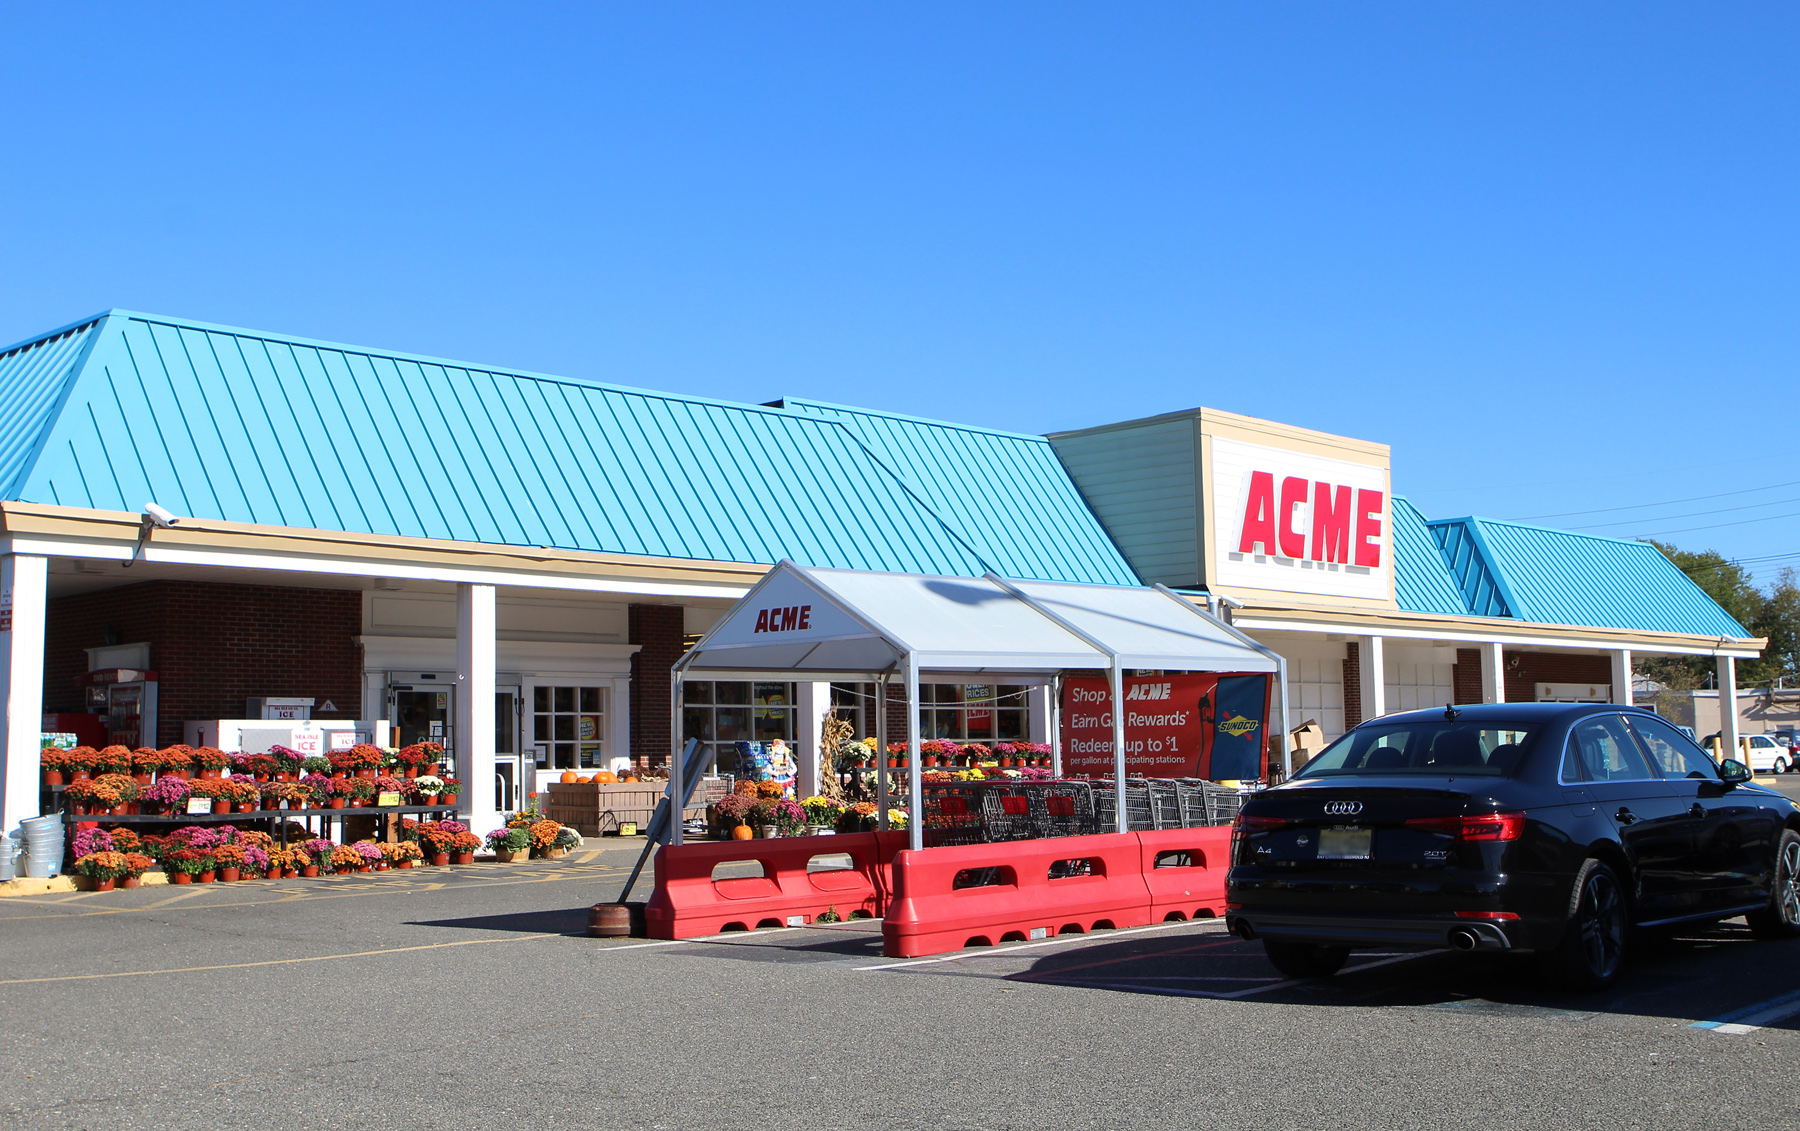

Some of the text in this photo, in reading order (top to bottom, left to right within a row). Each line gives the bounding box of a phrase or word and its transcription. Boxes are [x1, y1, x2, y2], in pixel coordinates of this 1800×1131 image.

[1239, 470, 1383, 568] ACME
[754, 605, 812, 634] ACME
[967, 688, 990, 698] RICES
[1072, 688, 1106, 705] Shop
[1126, 683, 1172, 701] ACME
[1072, 714, 1098, 728] Earn
[1219, 721, 1257, 731] SUNOCO
[298, 741, 316, 751] ICE
[1126, 741, 1143, 756] up
[1147, 738, 1162, 752] to
[1166, 736, 1179, 752] $1
[1070, 758, 1081, 766] per
[1081, 756, 1102, 766] gallon
[1110, 756, 1155, 766] picipating
[1156, 755, 1186, 764] stations
[1257, 846, 1272, 854] A4
